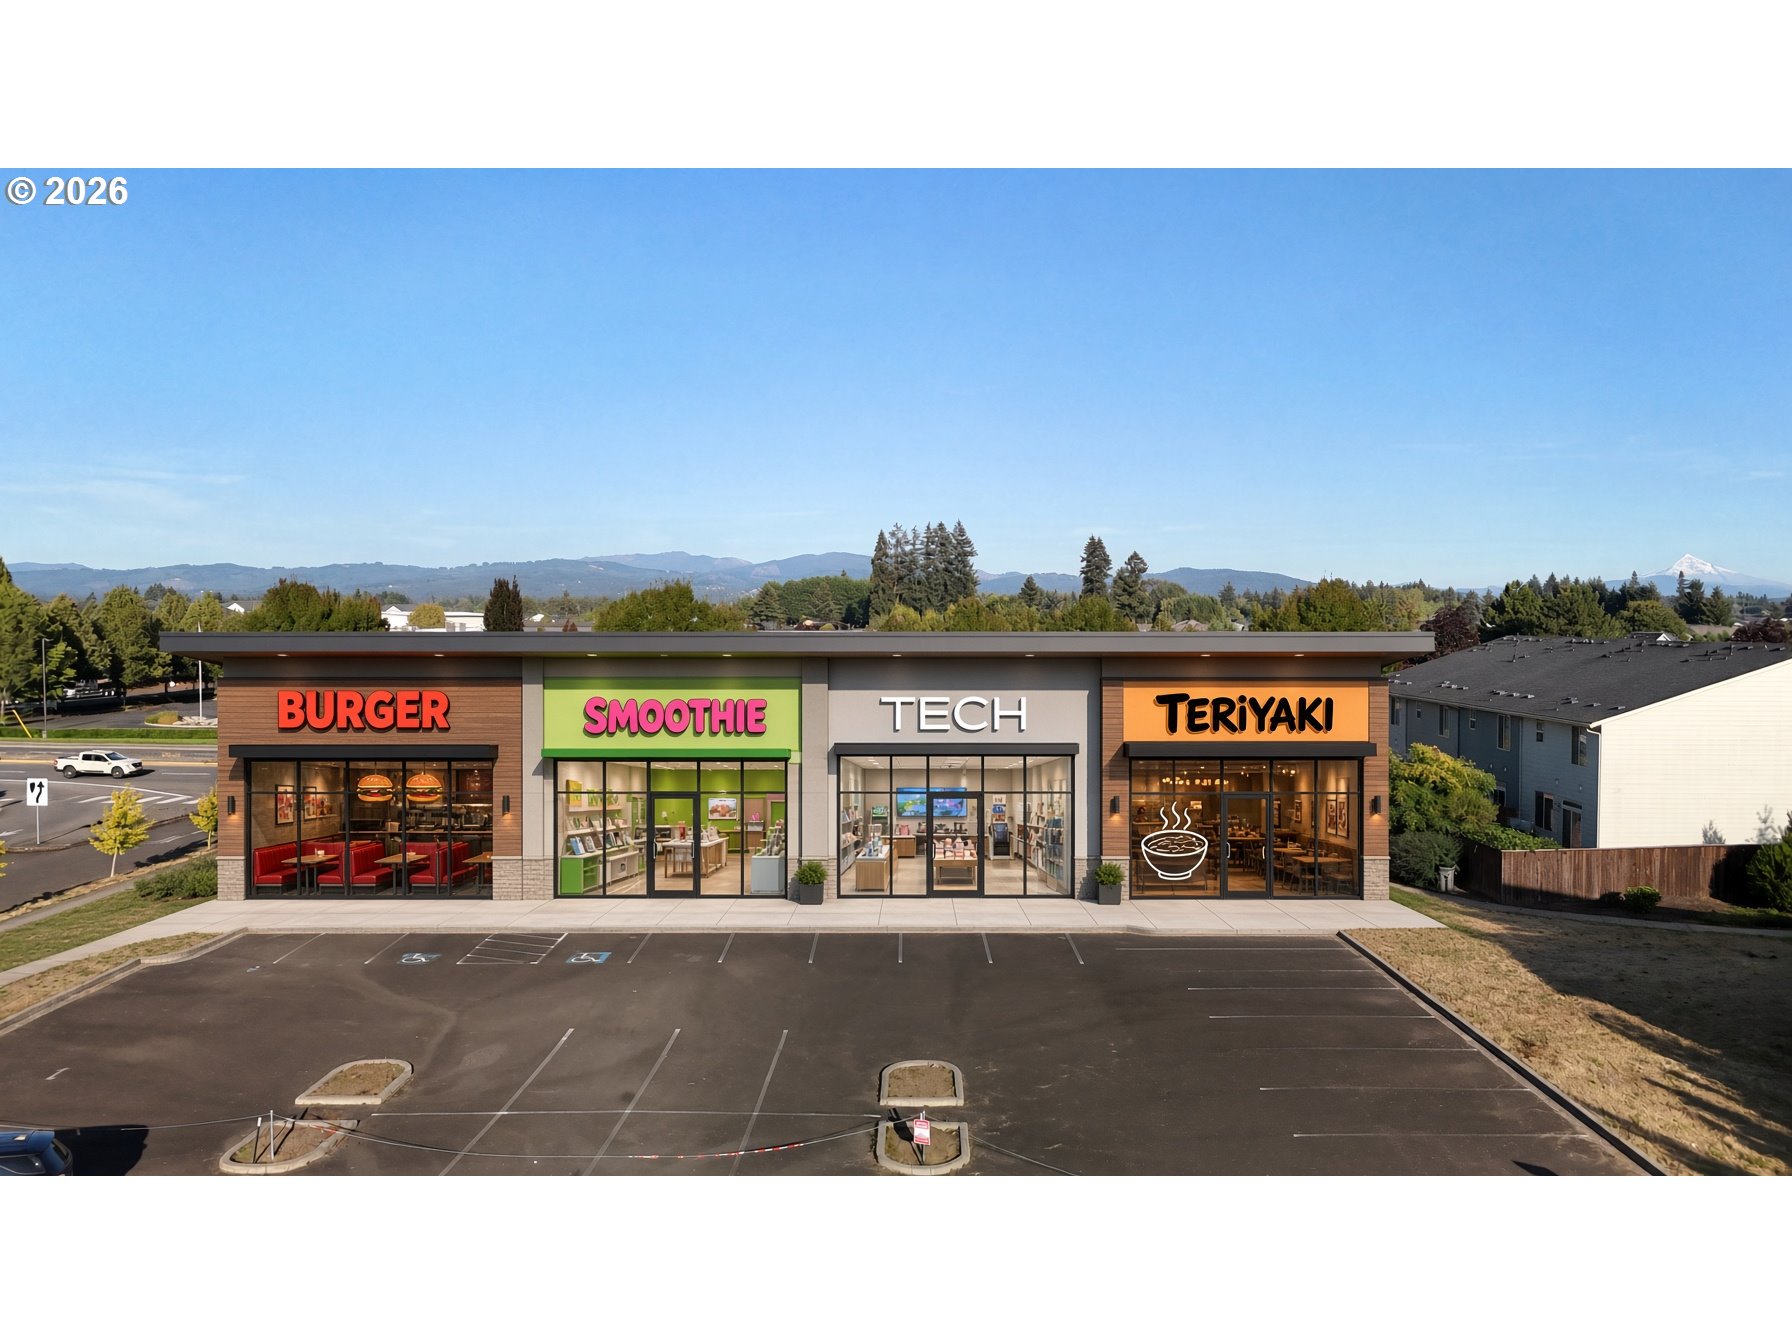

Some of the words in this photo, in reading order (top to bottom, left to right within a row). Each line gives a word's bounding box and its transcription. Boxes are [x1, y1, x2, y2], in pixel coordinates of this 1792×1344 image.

[278, 690, 450, 731] BURGER
[583, 696, 767, 735] SMOOTHIE
[880, 696, 1026, 732] TECH
